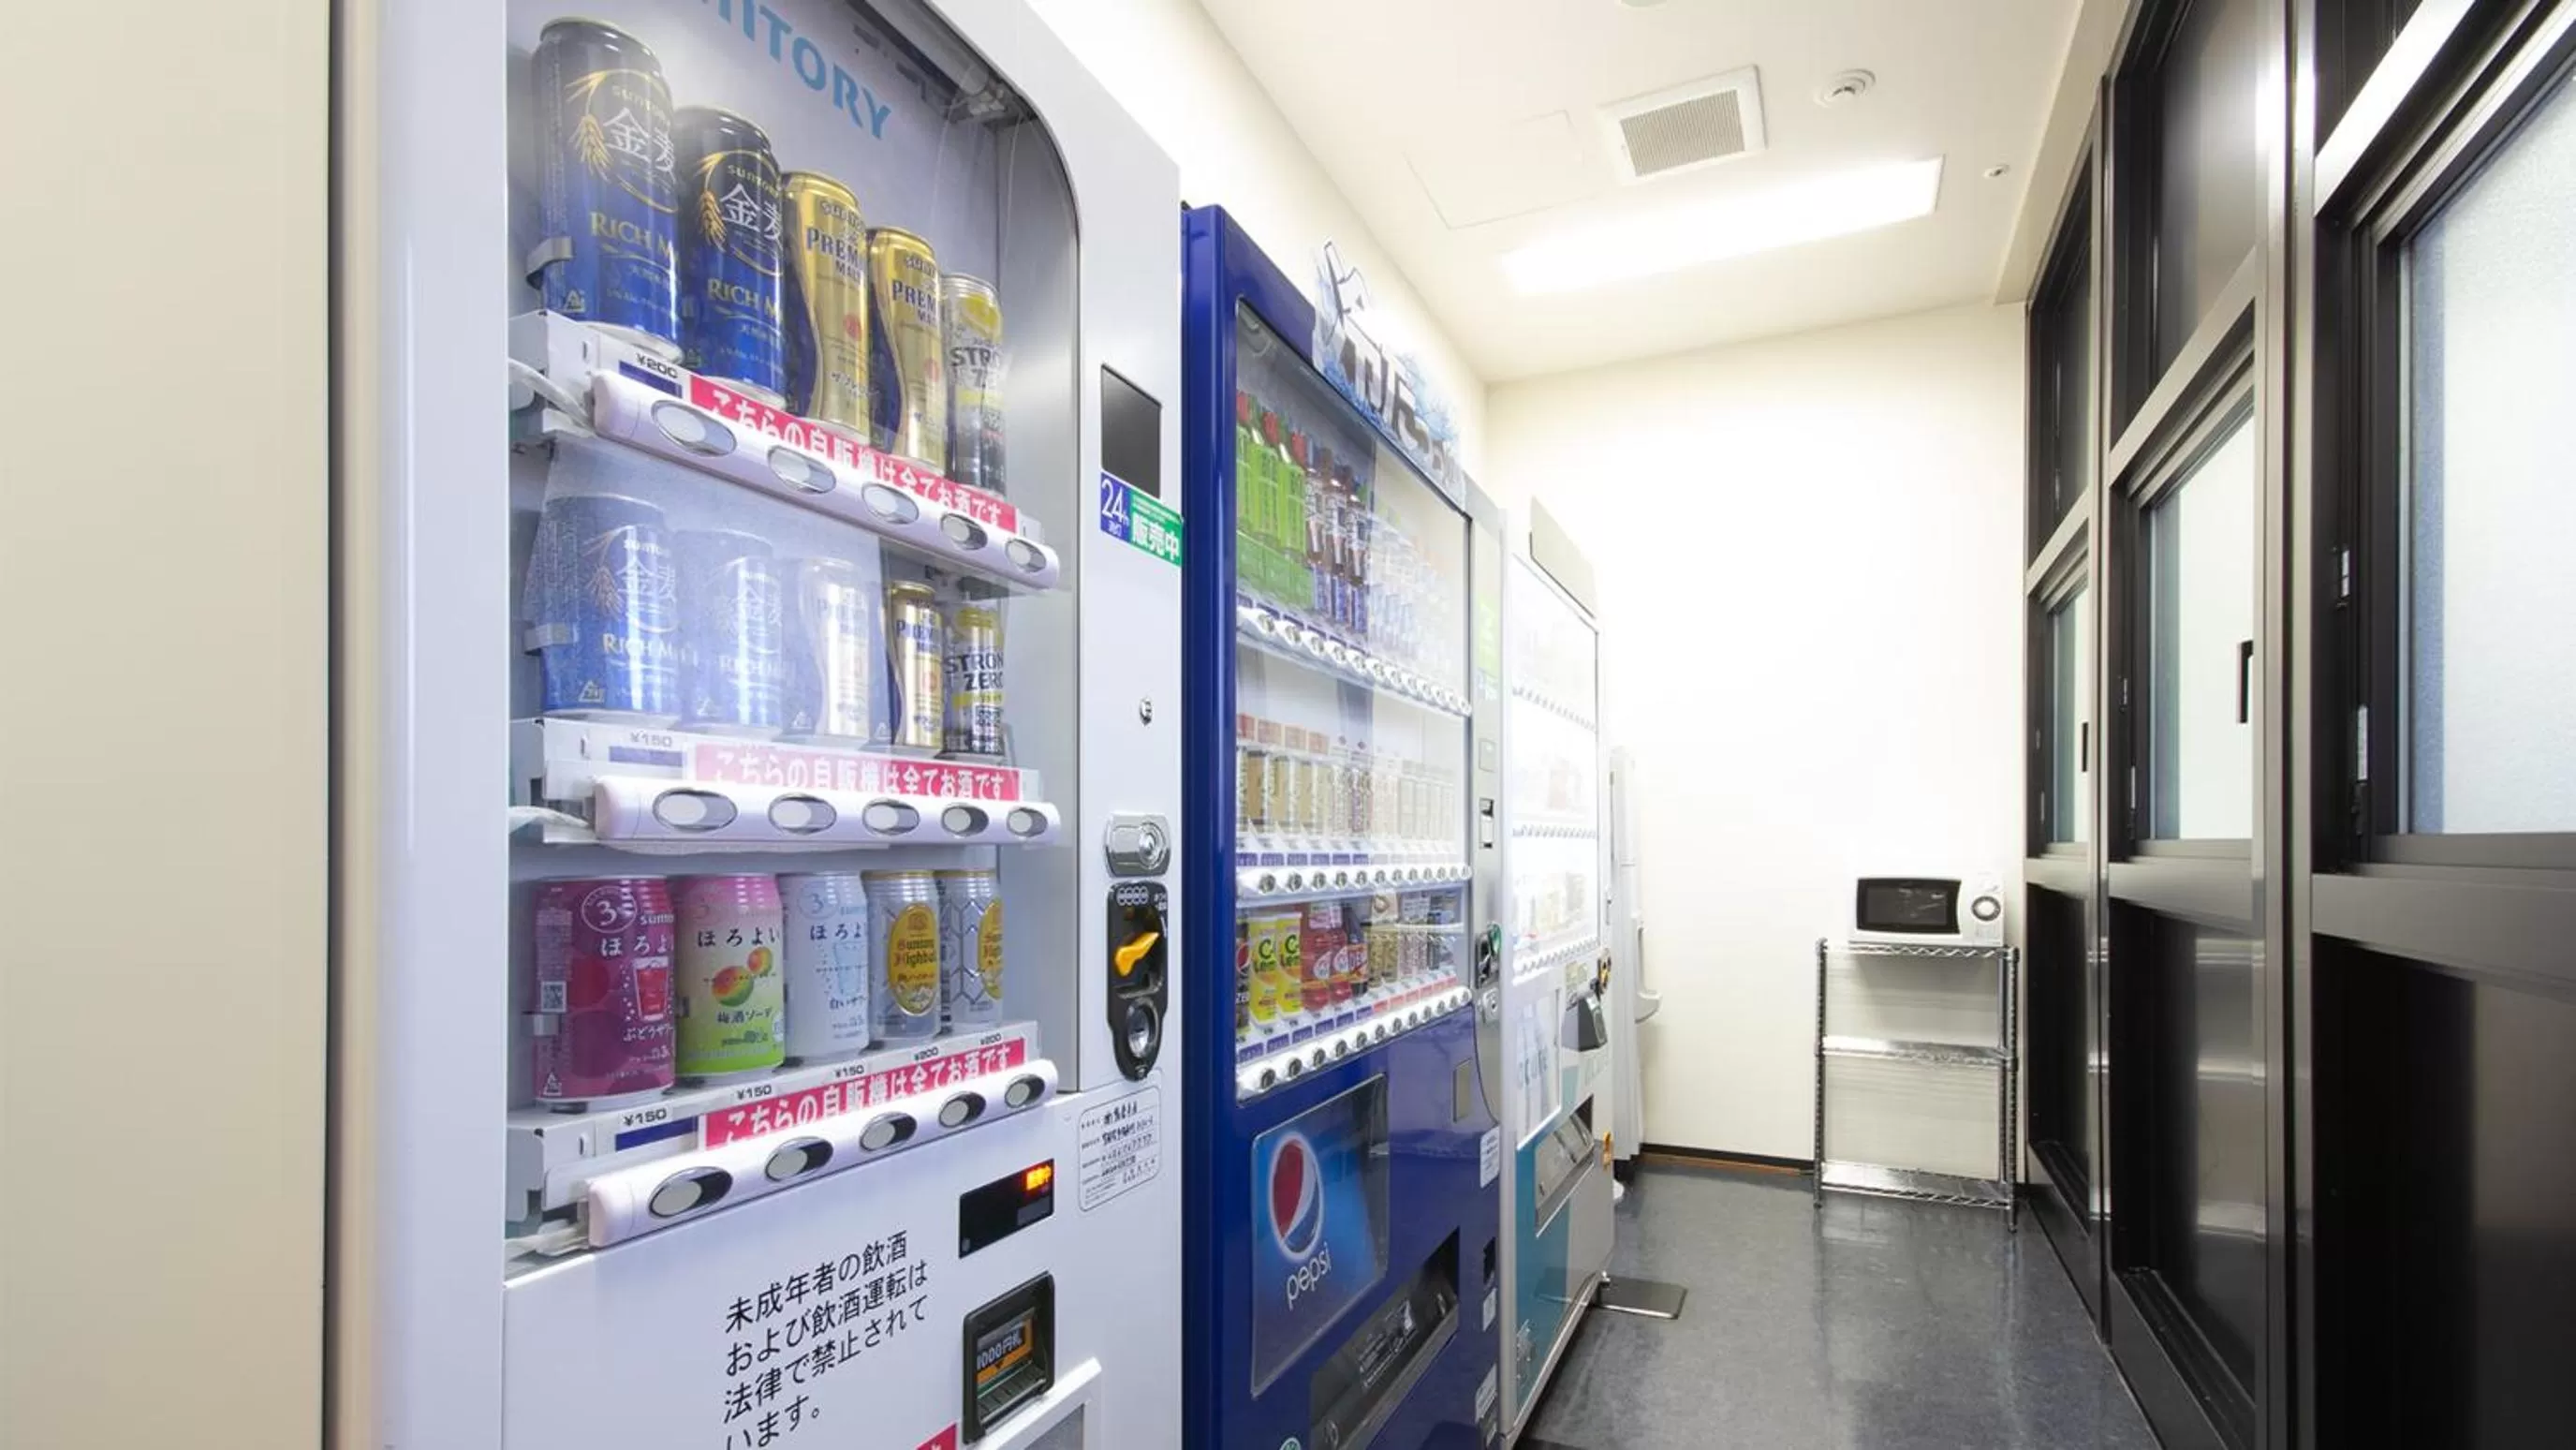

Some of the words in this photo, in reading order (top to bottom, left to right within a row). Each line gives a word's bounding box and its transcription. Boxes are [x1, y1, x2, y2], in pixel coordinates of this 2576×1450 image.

[591, 213, 652, 253] RICH
[708, 278, 759, 311] RICH
[636, 352, 678, 378] ¥200
[1132, 513, 1180, 560] 販売中
[630, 732, 672, 747] ¥150
[715, 750, 1005, 802] こちらの自販機は全てお酒です
[737, 1085, 772, 1102] ¥150
[834, 1064, 864, 1079] ¥150
[624, 1107, 668, 1128] ¥150
[727, 1047, 1011, 1146] こちらの自販機は全てお酒です
[726, 1230, 907, 1334] 未成年者の飲酒
[1287, 1241, 1332, 1311] pepsi
[727, 1259, 928, 1376] および飲酒運転は
[724, 1295, 928, 1424] 法律で禁止されて
[726, 1395, 820, 1450] います。
